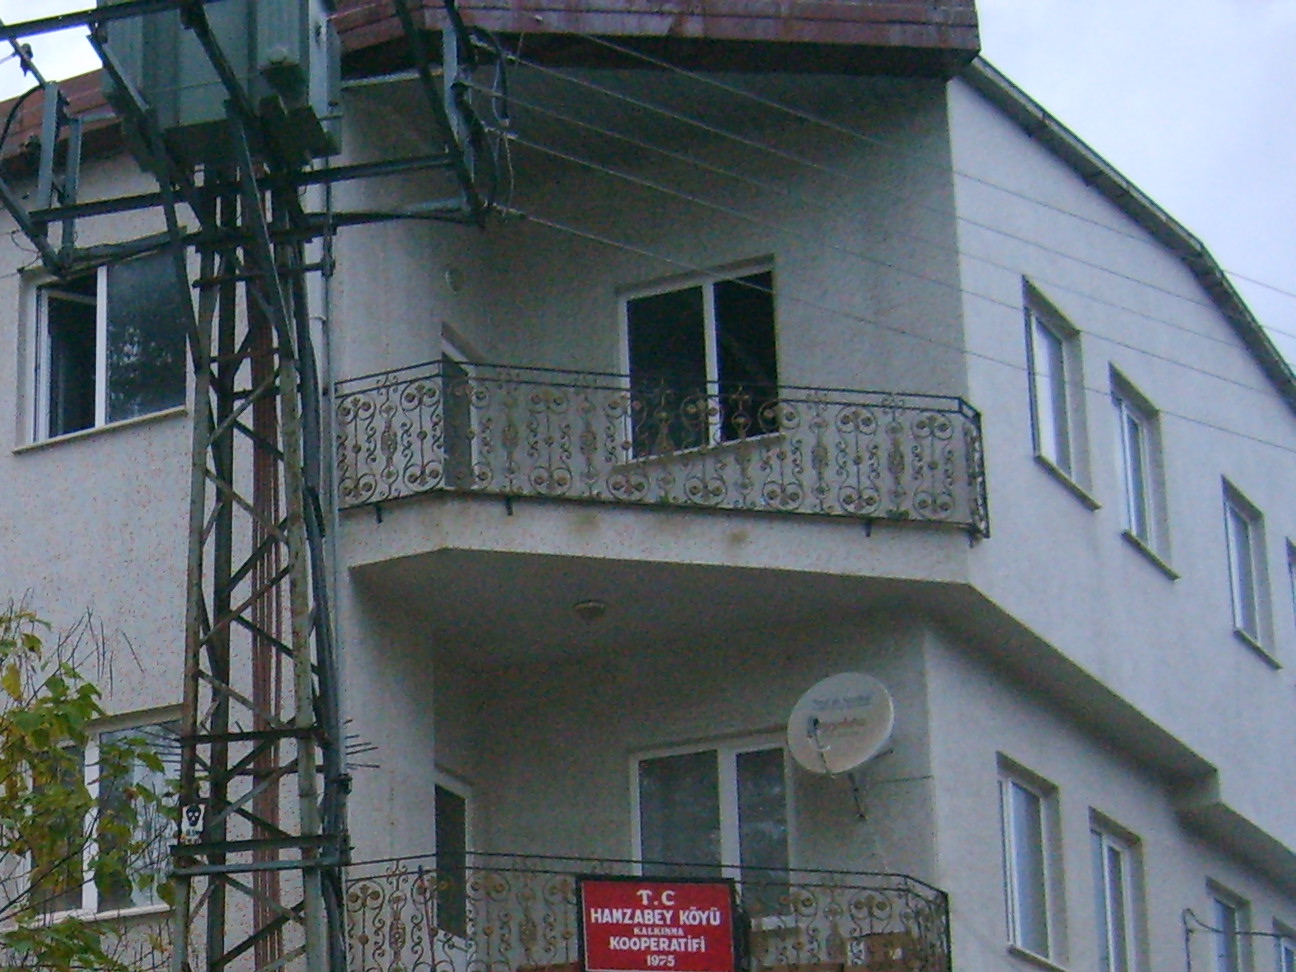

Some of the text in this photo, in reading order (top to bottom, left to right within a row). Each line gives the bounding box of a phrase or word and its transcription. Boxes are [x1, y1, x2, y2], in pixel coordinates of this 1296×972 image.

[590, 906, 721, 926] HAMZABEY KÖYÜ
[633, 926, 685, 936] KALKINMA
[609, 934, 706, 953] KOOPERATİFİ
[646, 955, 675, 967] 1975
